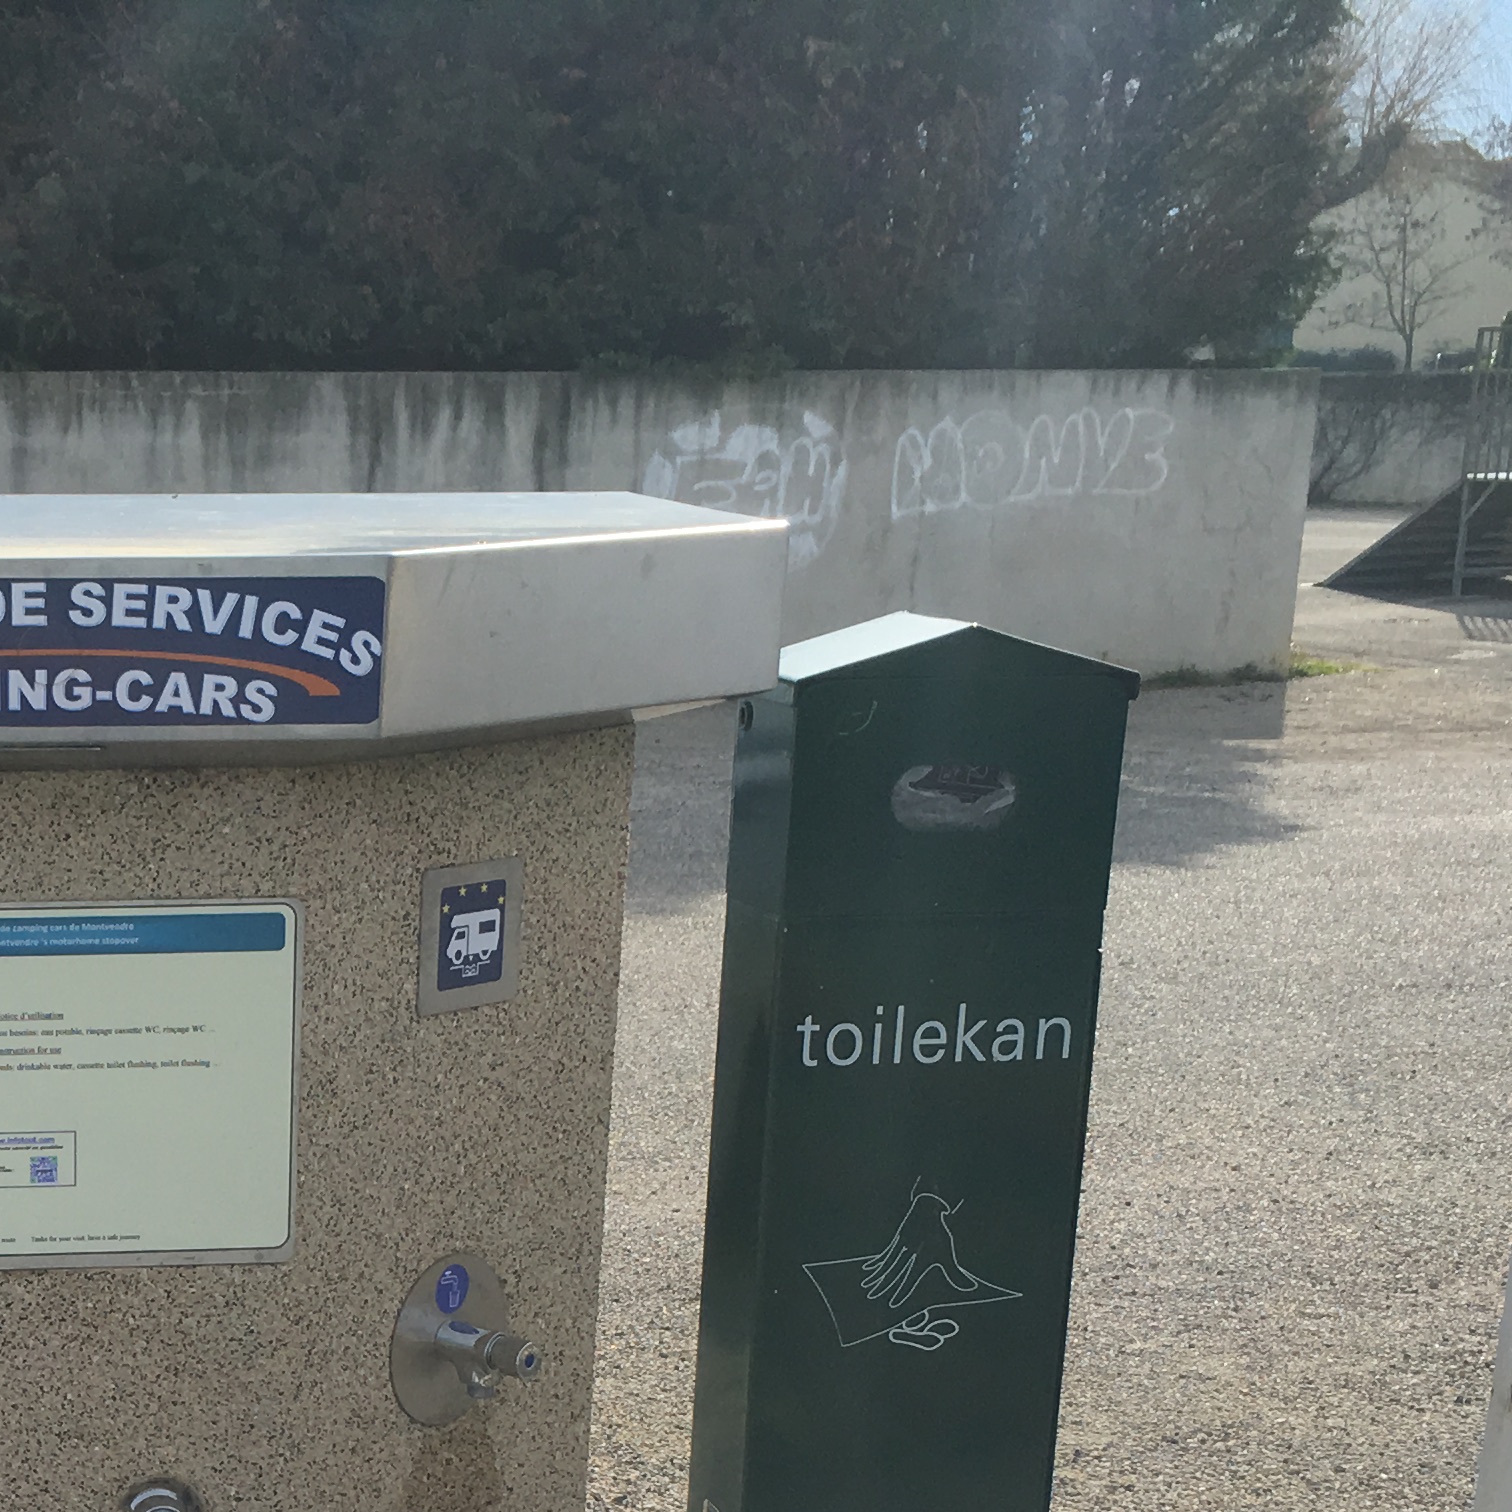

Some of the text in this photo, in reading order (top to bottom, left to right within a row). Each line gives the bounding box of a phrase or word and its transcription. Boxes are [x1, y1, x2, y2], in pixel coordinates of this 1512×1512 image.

[68, 582, 381, 676] SERVICES
[50, 924, 67, 932] cars
[69, 922, 80, 931] de
[192, 1024, 206, 1033] WC
[796, 1002, 1072, 1067] toilekan
[37, 1046, 48, 1055] for
[16, 1062, 51, 1071] drinkable
